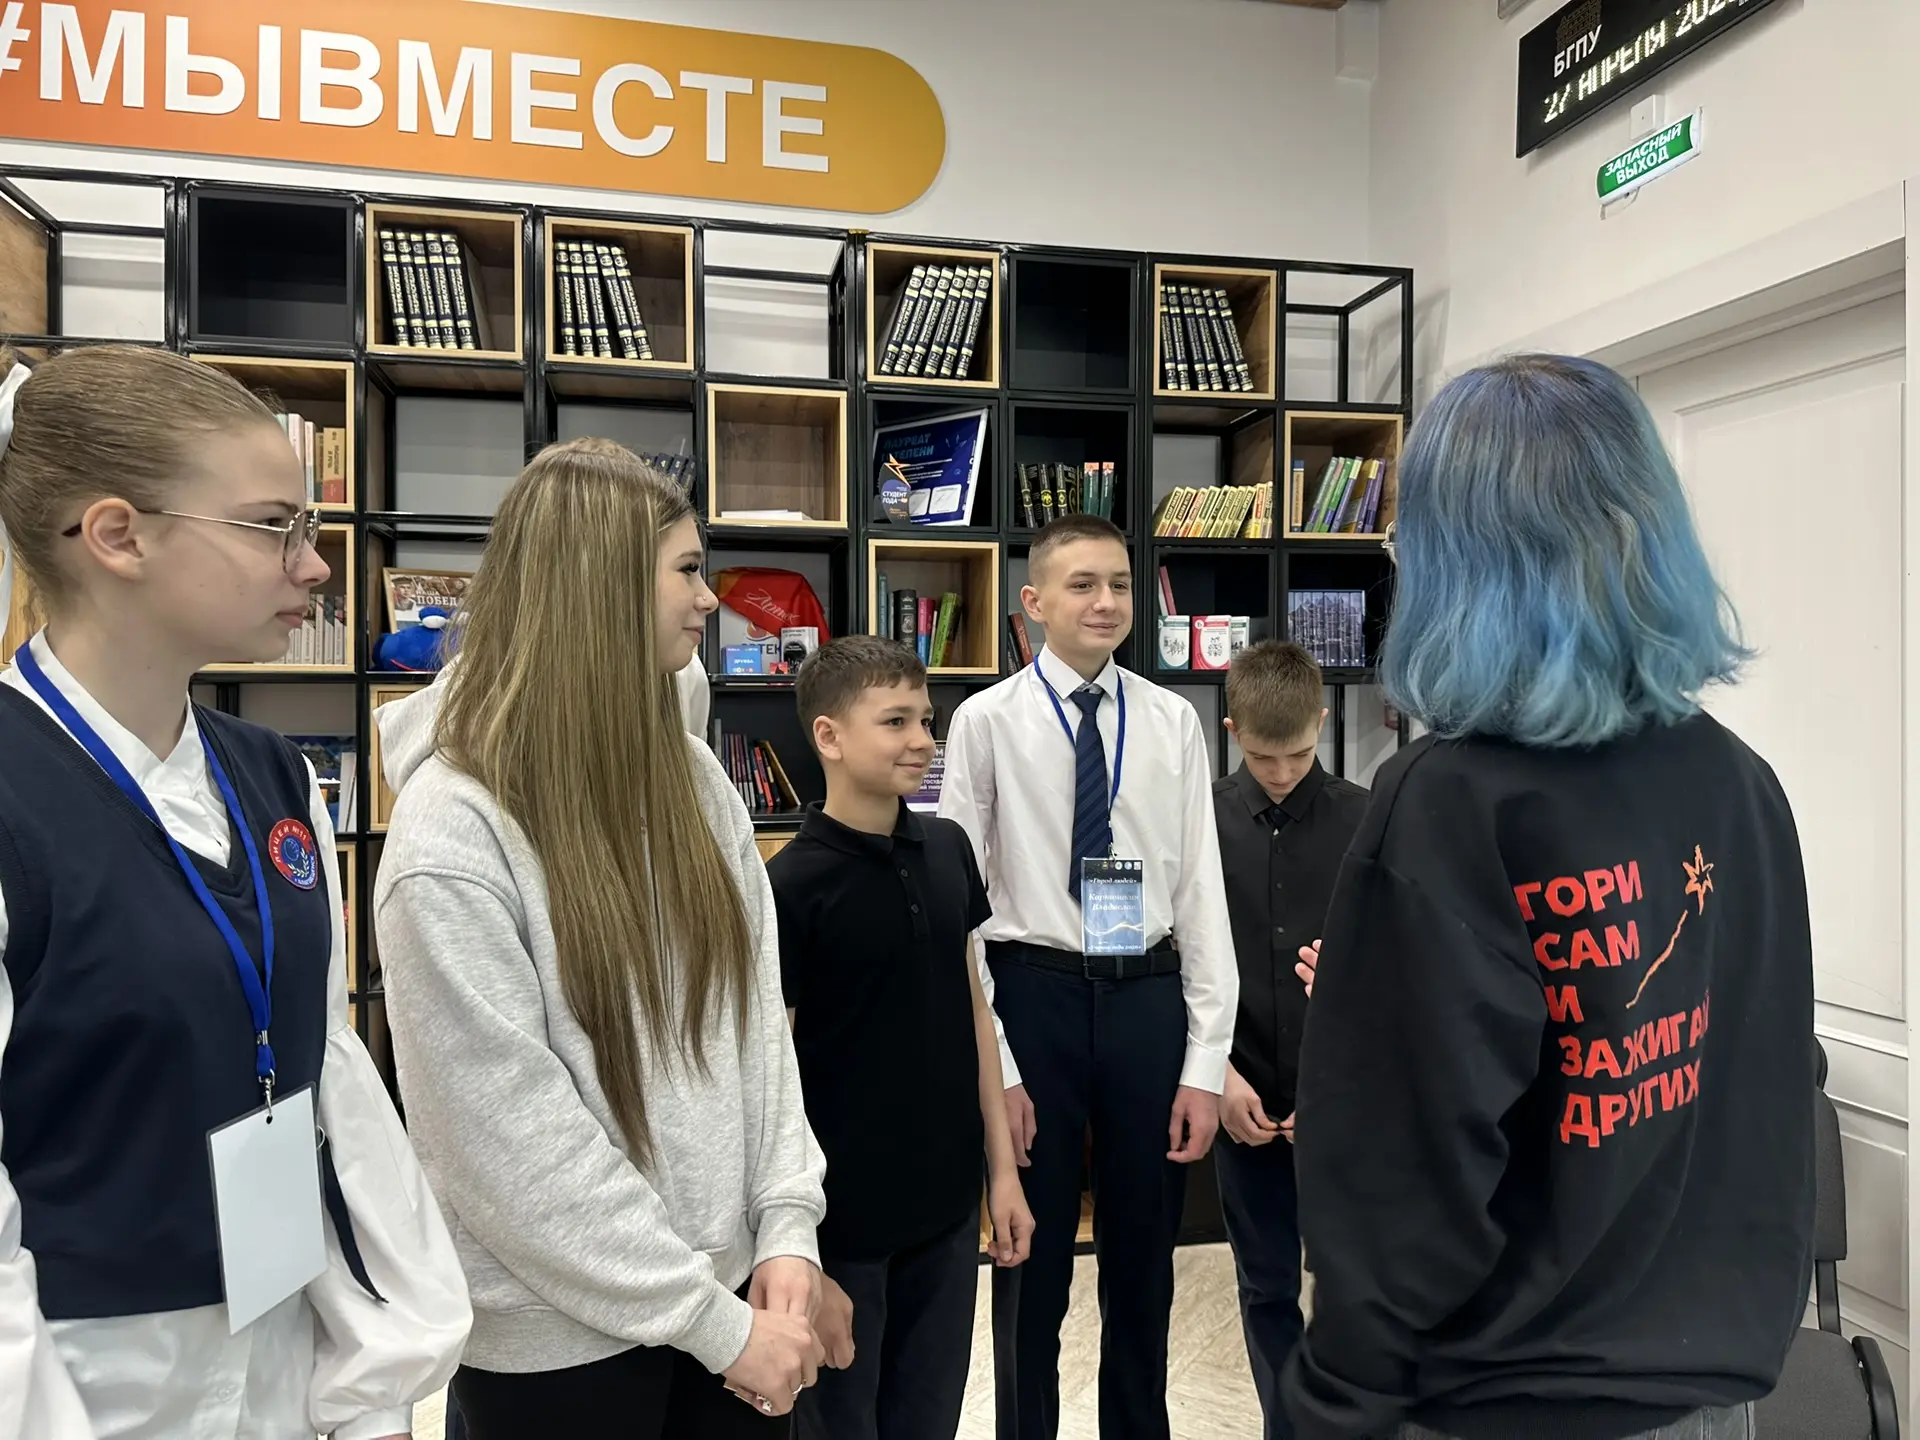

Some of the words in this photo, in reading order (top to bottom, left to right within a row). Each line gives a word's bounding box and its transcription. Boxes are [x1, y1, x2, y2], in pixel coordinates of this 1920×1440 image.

[1675, 0, 1736, 37] 20
[1553, 24, 1602, 78] БГПУ
[1604, 123, 1682, 177] ЗАПАСНЫЙ
[1616, 145, 1670, 185] ВЫХОД
[414, 326, 423, 334] 10
[430, 327, 438, 335] 11
[444, 327, 453, 335] 12
[639, 337, 647, 345] 18
[887, 351, 896, 360] 19
[901, 351, 910, 360] 20
[915, 351, 923, 361] 21
[886, 445, 935, 460] ТЕПЕНИ
[417, 595, 458, 607] ПОБЕД
[1513, 860, 1643, 921] ГОРИ
[1533, 919, 1641, 971] САМ
[1544, 985, 1585, 1023] И
[1560, 1057, 1700, 1148] ДРУГИХ
